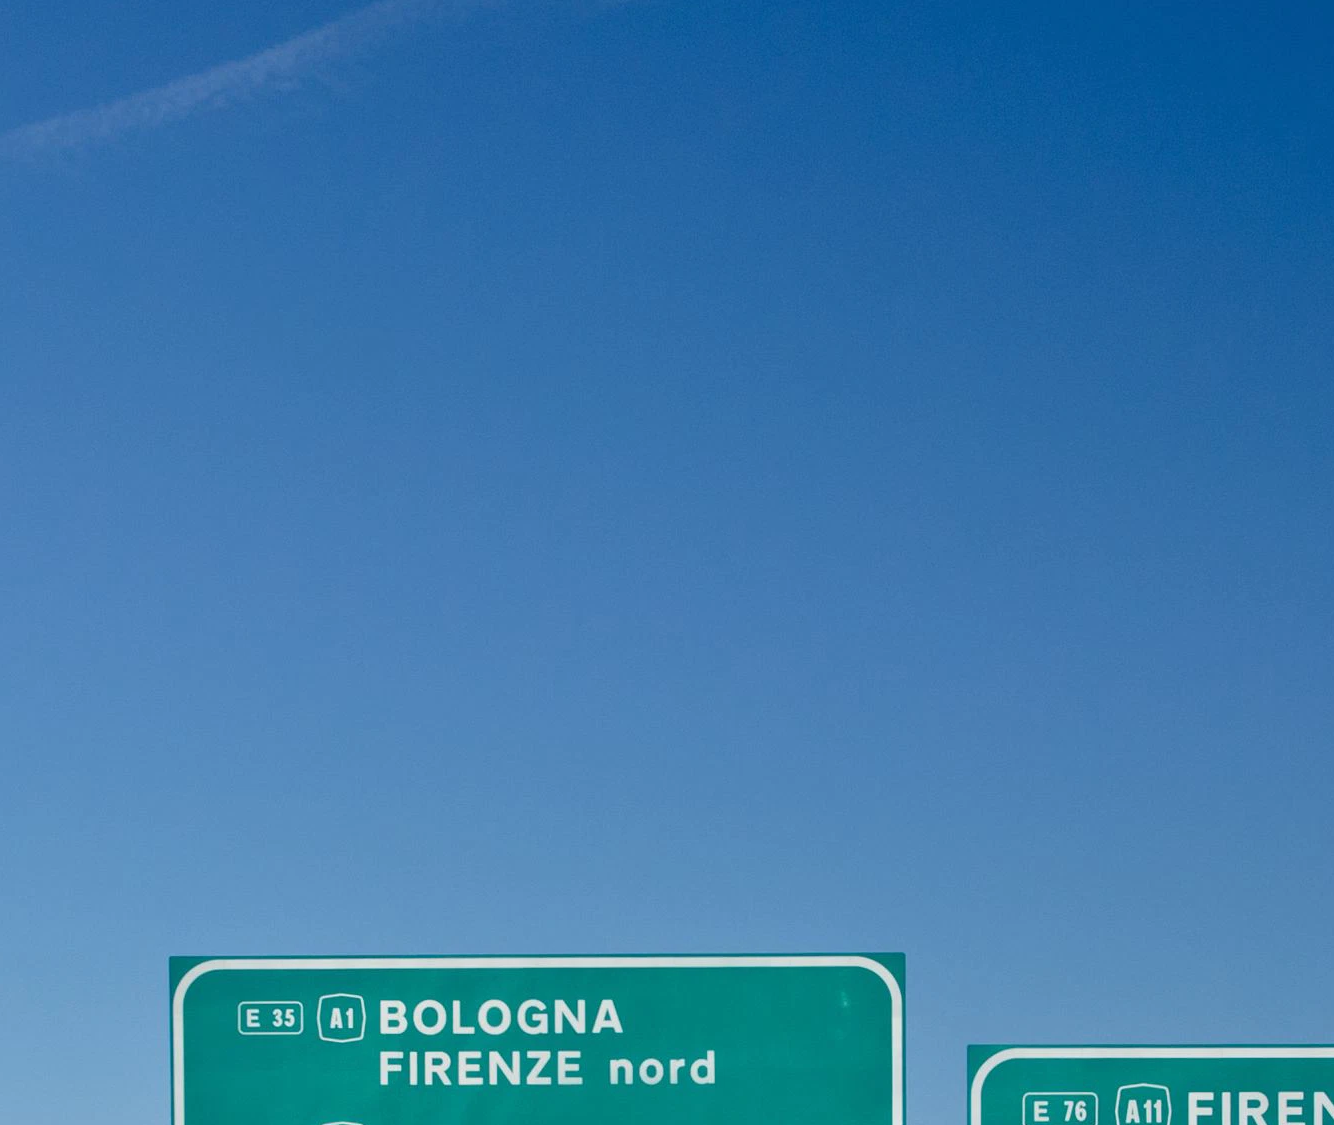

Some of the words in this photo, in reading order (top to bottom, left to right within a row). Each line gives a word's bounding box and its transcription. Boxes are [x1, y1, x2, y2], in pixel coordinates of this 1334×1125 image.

[246, 1008, 261, 1028] E
[272, 1008, 296, 1028] 35
[329, 1007, 354, 1029] A1
[379, 999, 624, 1036] BOLOGNA
[379, 1050, 583, 1086] FIRENZE
[609, 1050, 716, 1085] nord
[1033, 1100, 1050, 1122] E
[1063, 1100, 1087, 1122] 76
[1125, 1099, 1163, 1124] A11
